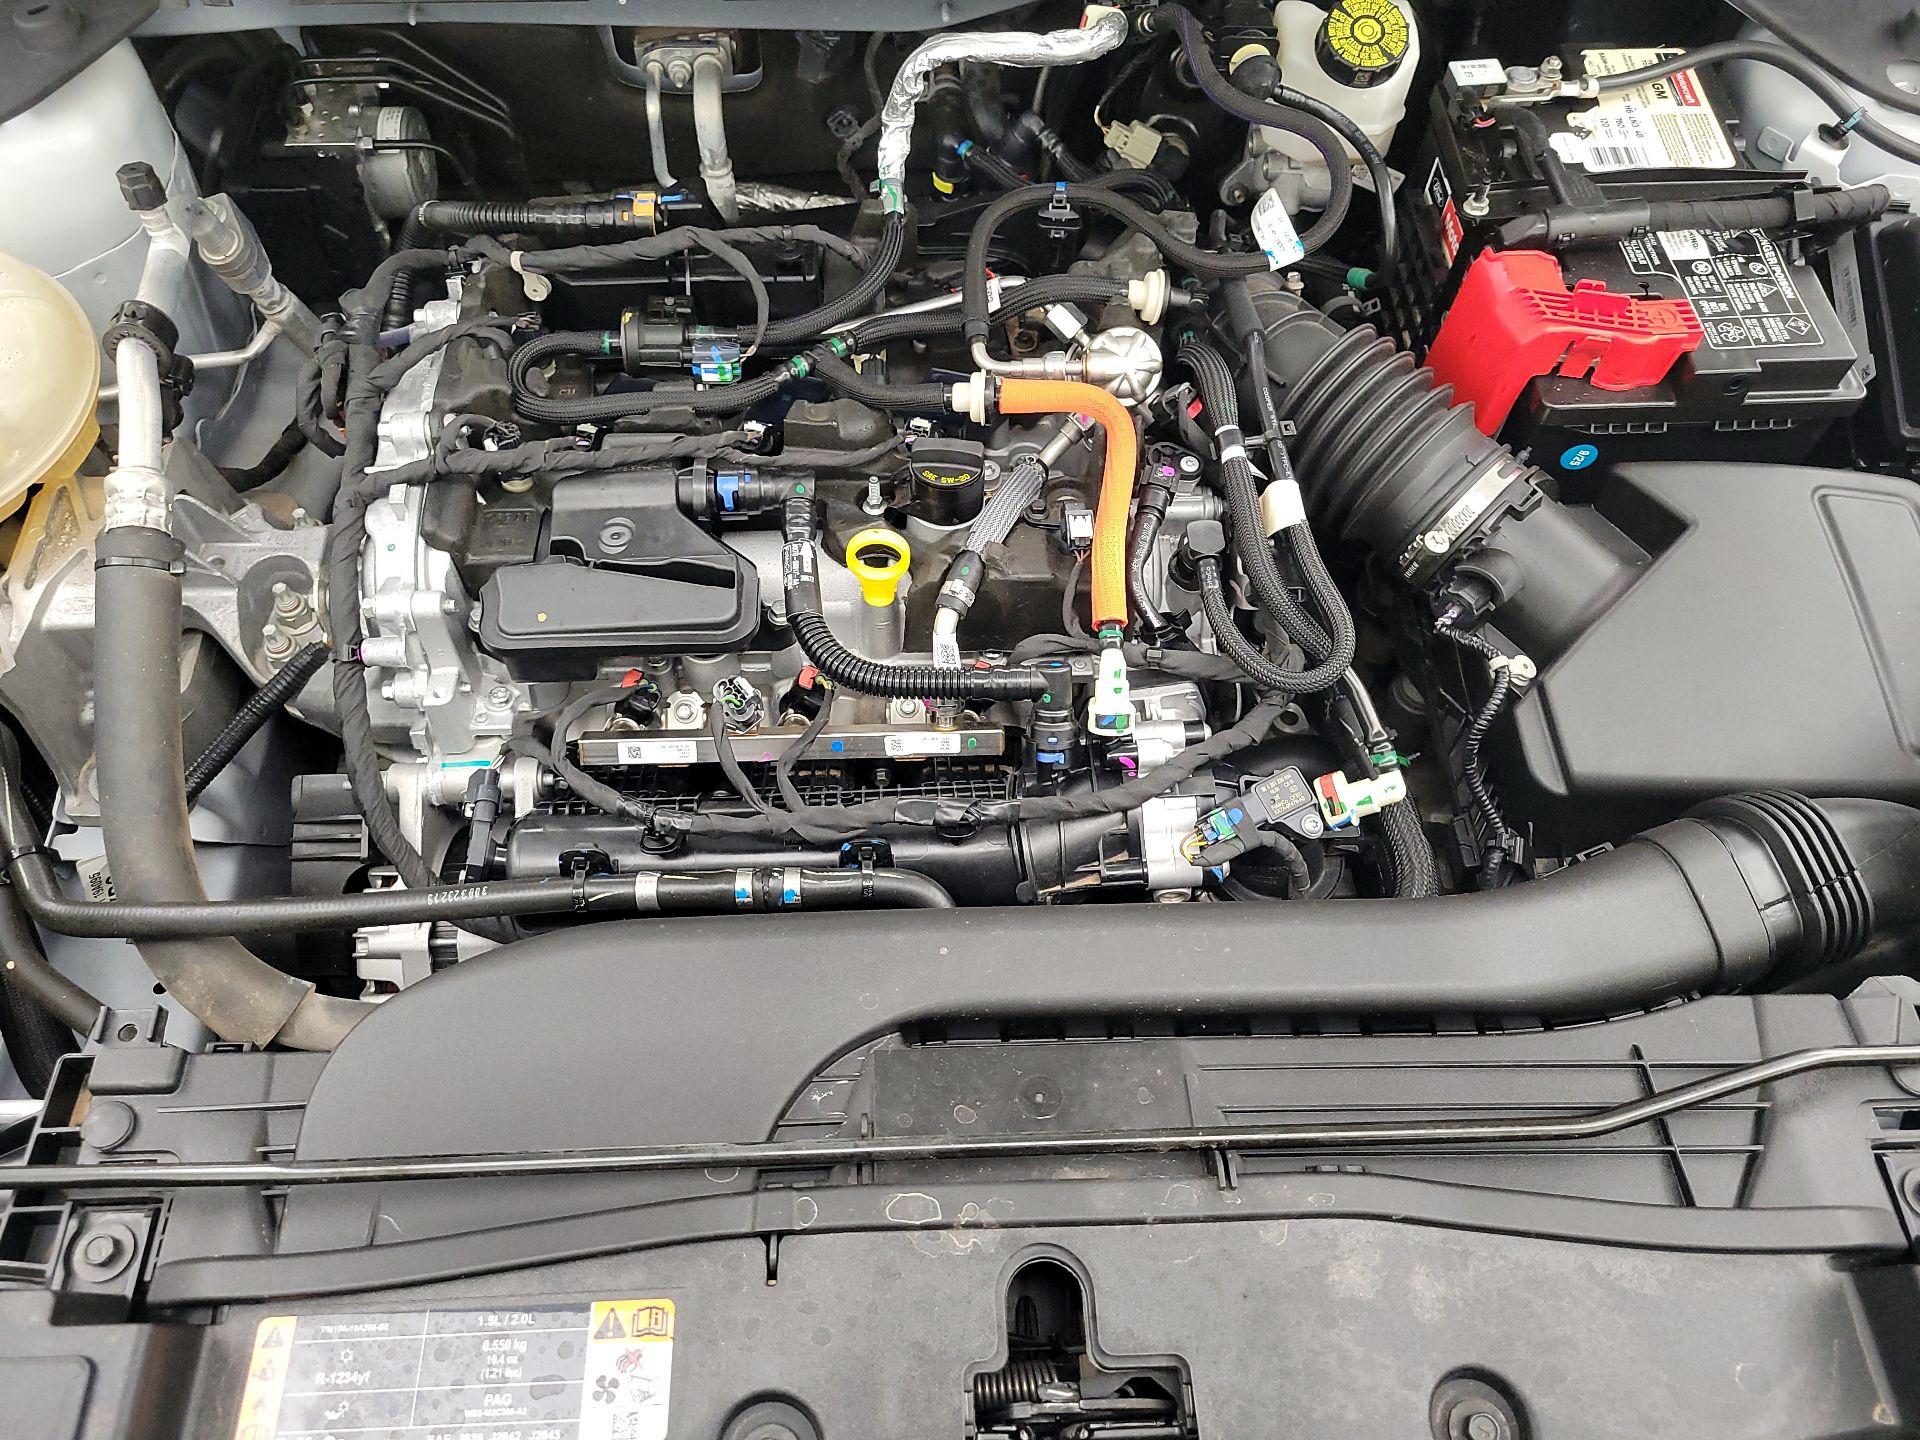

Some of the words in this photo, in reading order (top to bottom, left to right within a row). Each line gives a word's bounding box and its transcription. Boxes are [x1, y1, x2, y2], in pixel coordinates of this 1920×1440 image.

[1674, 73, 1694, 103] Motorcraft
[1262, 387, 1273, 411] COOPER
[1569, 450, 1589, 465] 9/25
[922, 470, 937, 480] SAE
[940, 473, 970, 482] 5W-20
[514, 1314, 535, 1326] 2.0L
[482, 1339, 510, 1352] 0.550
[512, 1339, 527, 1353] kg
[315, 1371, 370, 1385] R-1234yf
[484, 1392, 512, 1407] PAG
